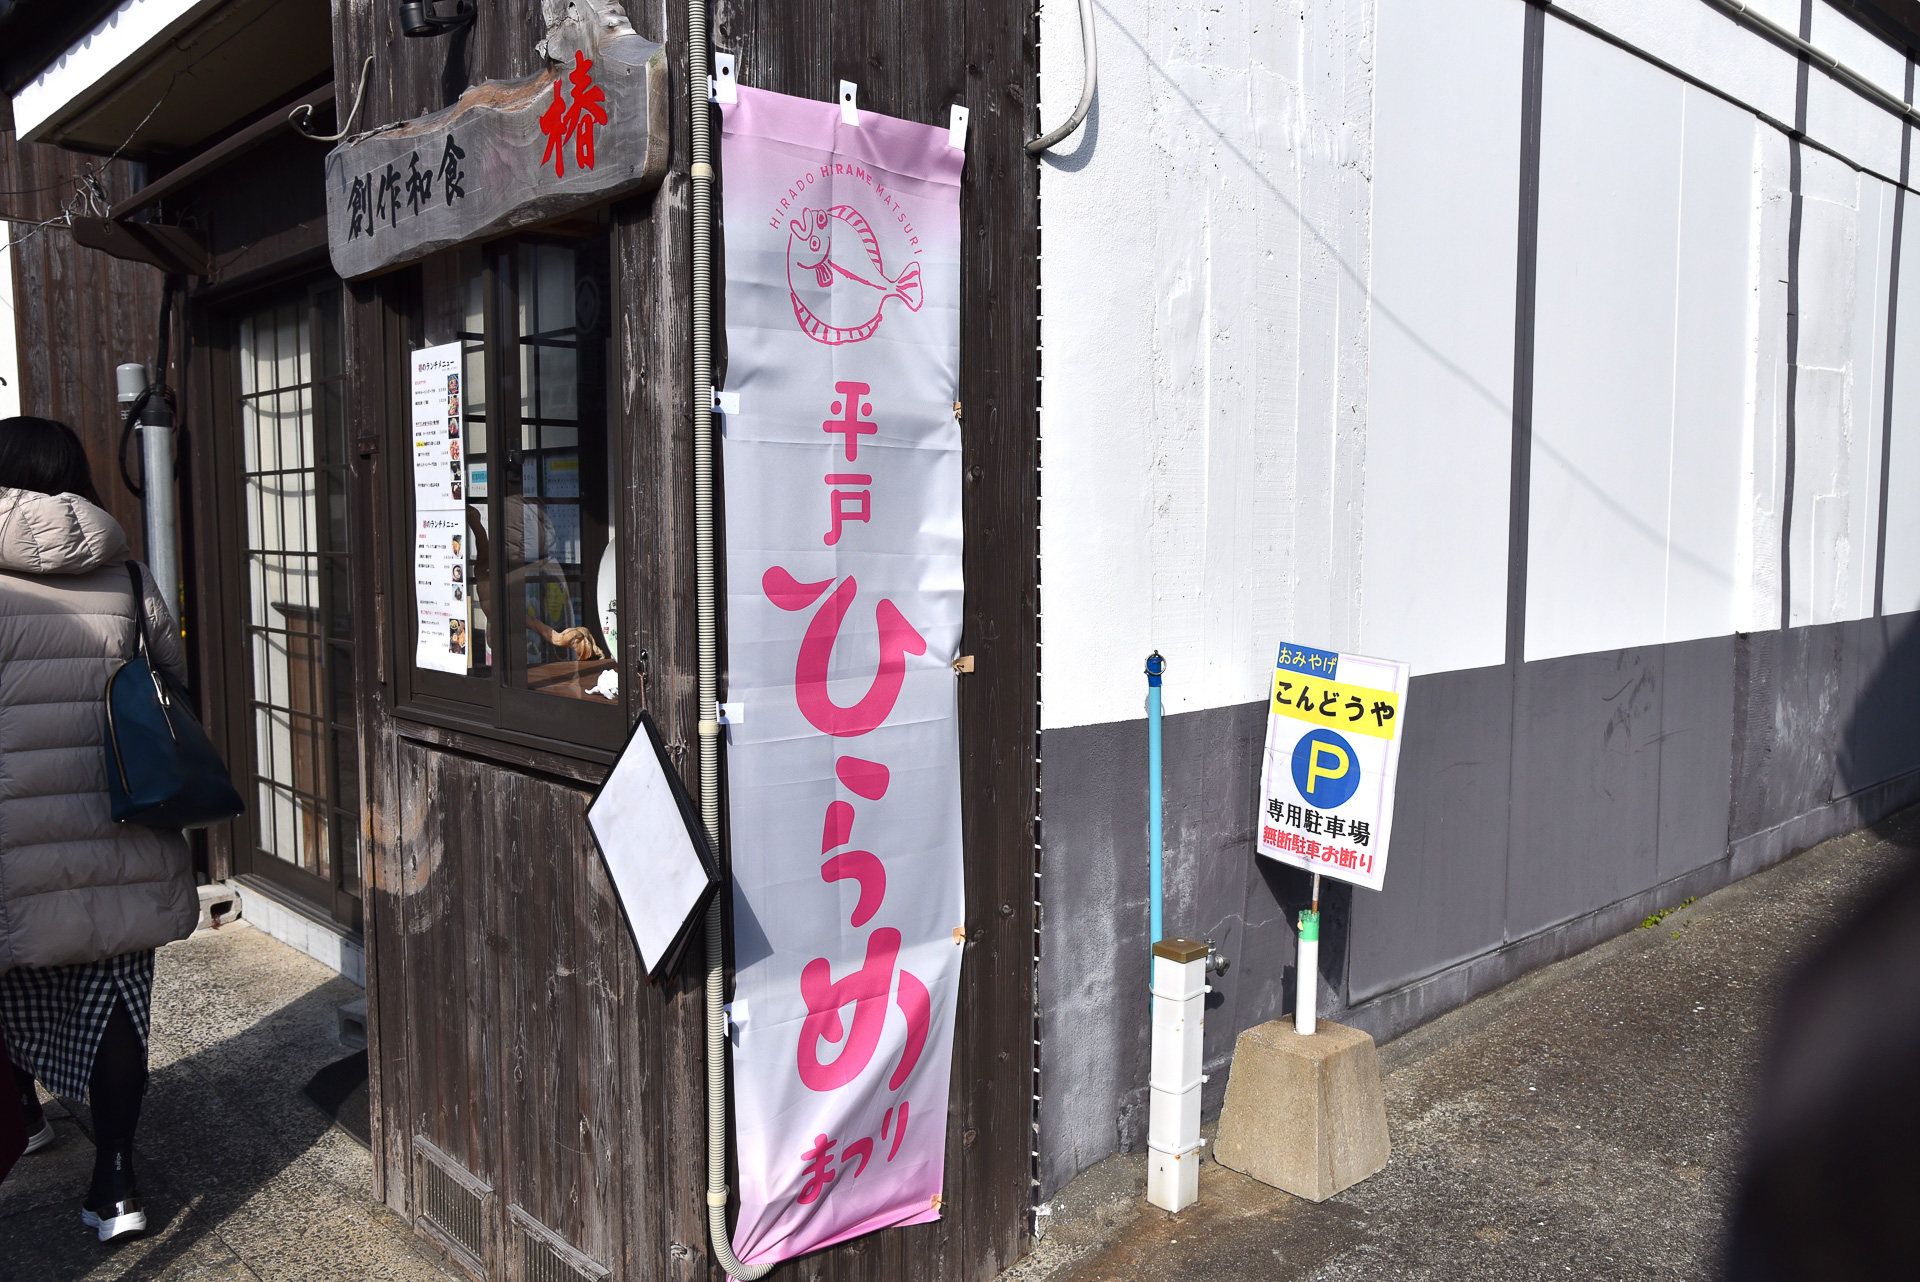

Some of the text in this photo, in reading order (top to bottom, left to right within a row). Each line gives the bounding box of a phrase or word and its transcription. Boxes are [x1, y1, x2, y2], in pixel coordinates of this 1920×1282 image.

[540, 50, 607, 177] 椿
[347, 134, 466, 242] 創作和食
[770, 163, 923, 255] HIRADO HIRAME MATSURI
[1279, 646, 1338, 675] おみやげ
[1276, 681, 1395, 727] こんどうや
[763, 382, 930, 1205] 平戸 ひらめ まつり
[1306, 739, 1350, 794] P
[1263, 825, 1373, 874] 無断駐車お断り
[1267, 798, 1371, 847] 専用駐車場
